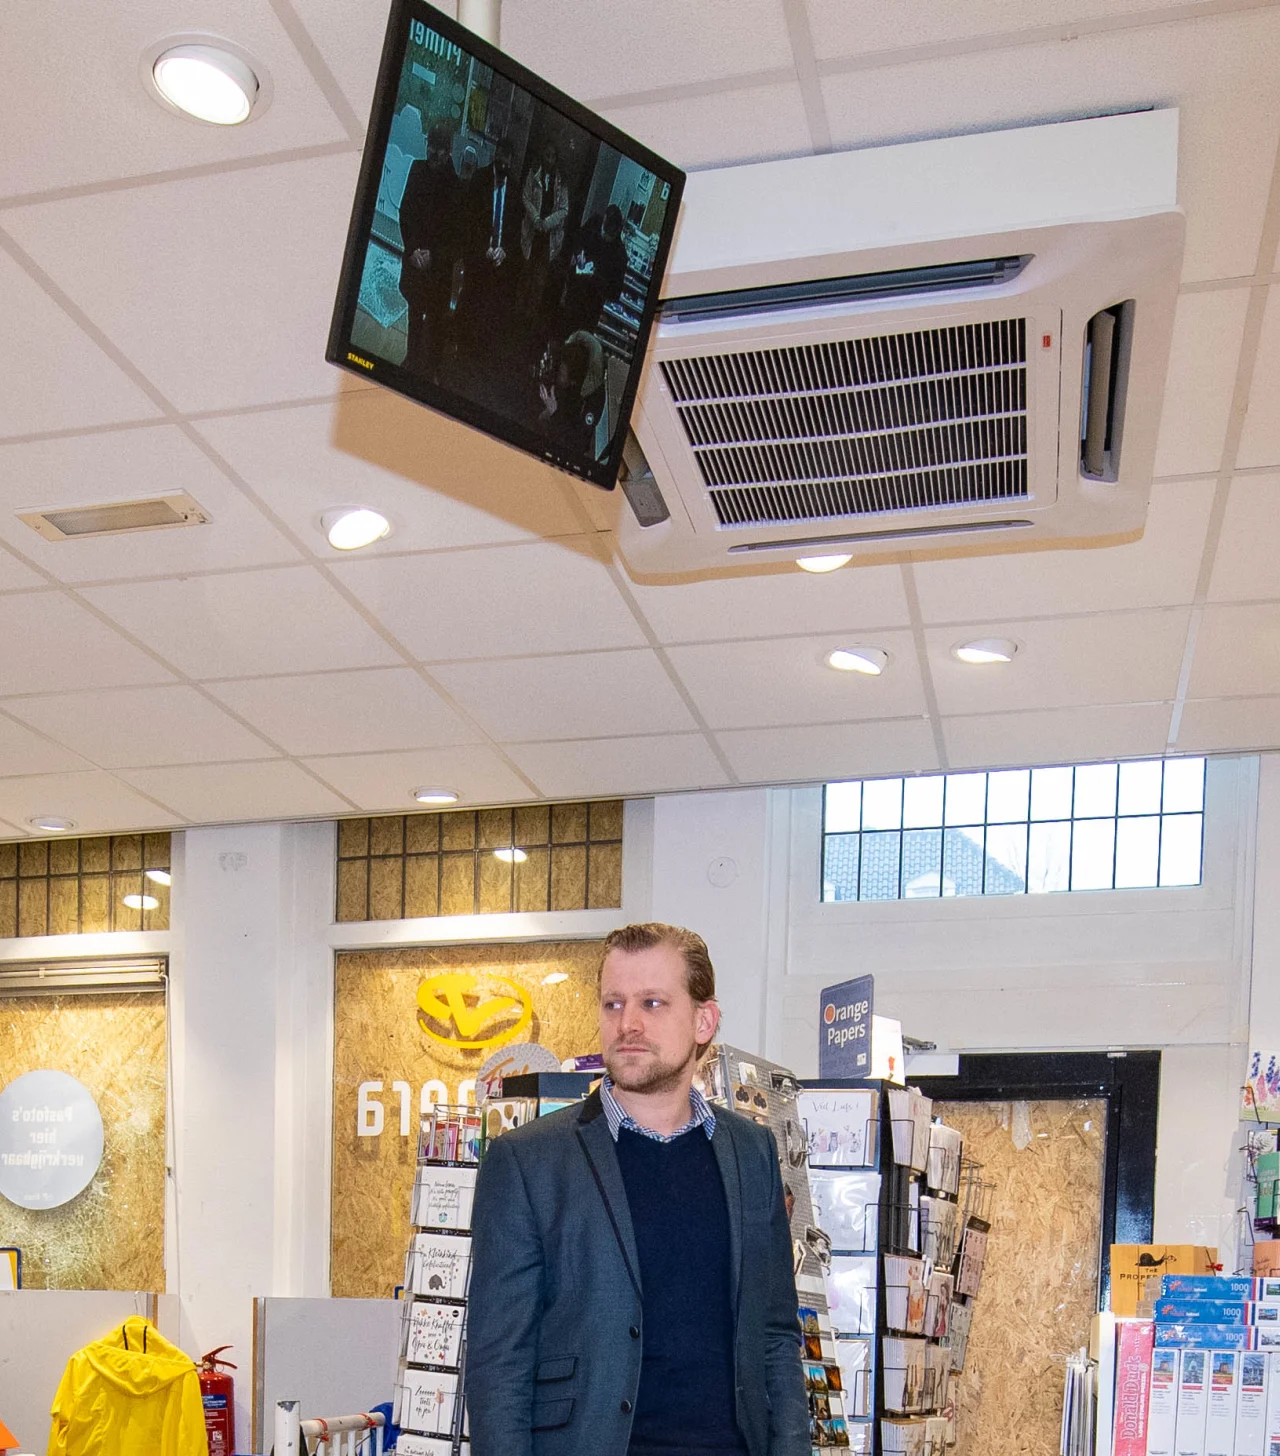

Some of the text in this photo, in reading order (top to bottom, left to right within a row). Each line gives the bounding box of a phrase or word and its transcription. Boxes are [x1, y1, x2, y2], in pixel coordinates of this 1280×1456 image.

[347, 352, 375, 370] STANLEY
[823, 1000, 869, 1025] Orange
[827, 1023, 866, 1048] Papers
[1231, 1282, 1249, 1292] 1000
[1222, 1307, 1241, 1317] 1000
[1225, 1333, 1243, 1342] 1000
[1121, 1356, 1141, 1440] Donald Duck
